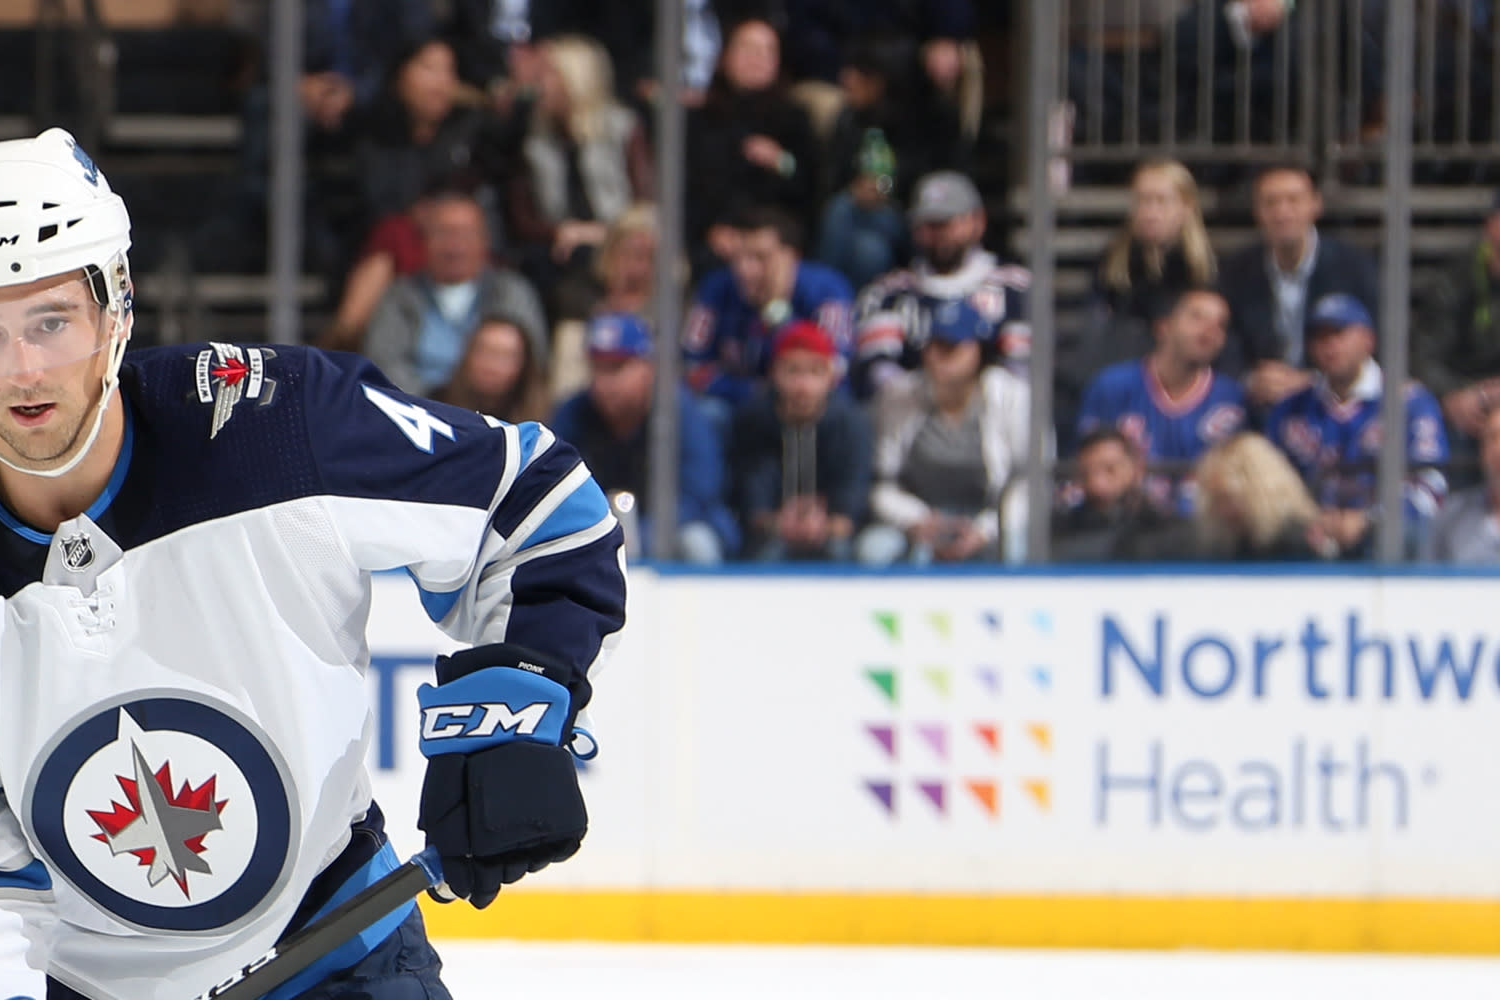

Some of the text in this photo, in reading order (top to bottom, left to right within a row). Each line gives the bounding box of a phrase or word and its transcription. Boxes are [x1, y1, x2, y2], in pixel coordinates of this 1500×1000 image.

[197, 351, 210, 399] WINNIPEG
[361, 383, 457, 454] 4
[70, 543, 86, 567] NHL
[518, 661, 546, 675] PIONK
[1101, 611, 1500, 700] Northw
[1097, 738, 1408, 829] Health
